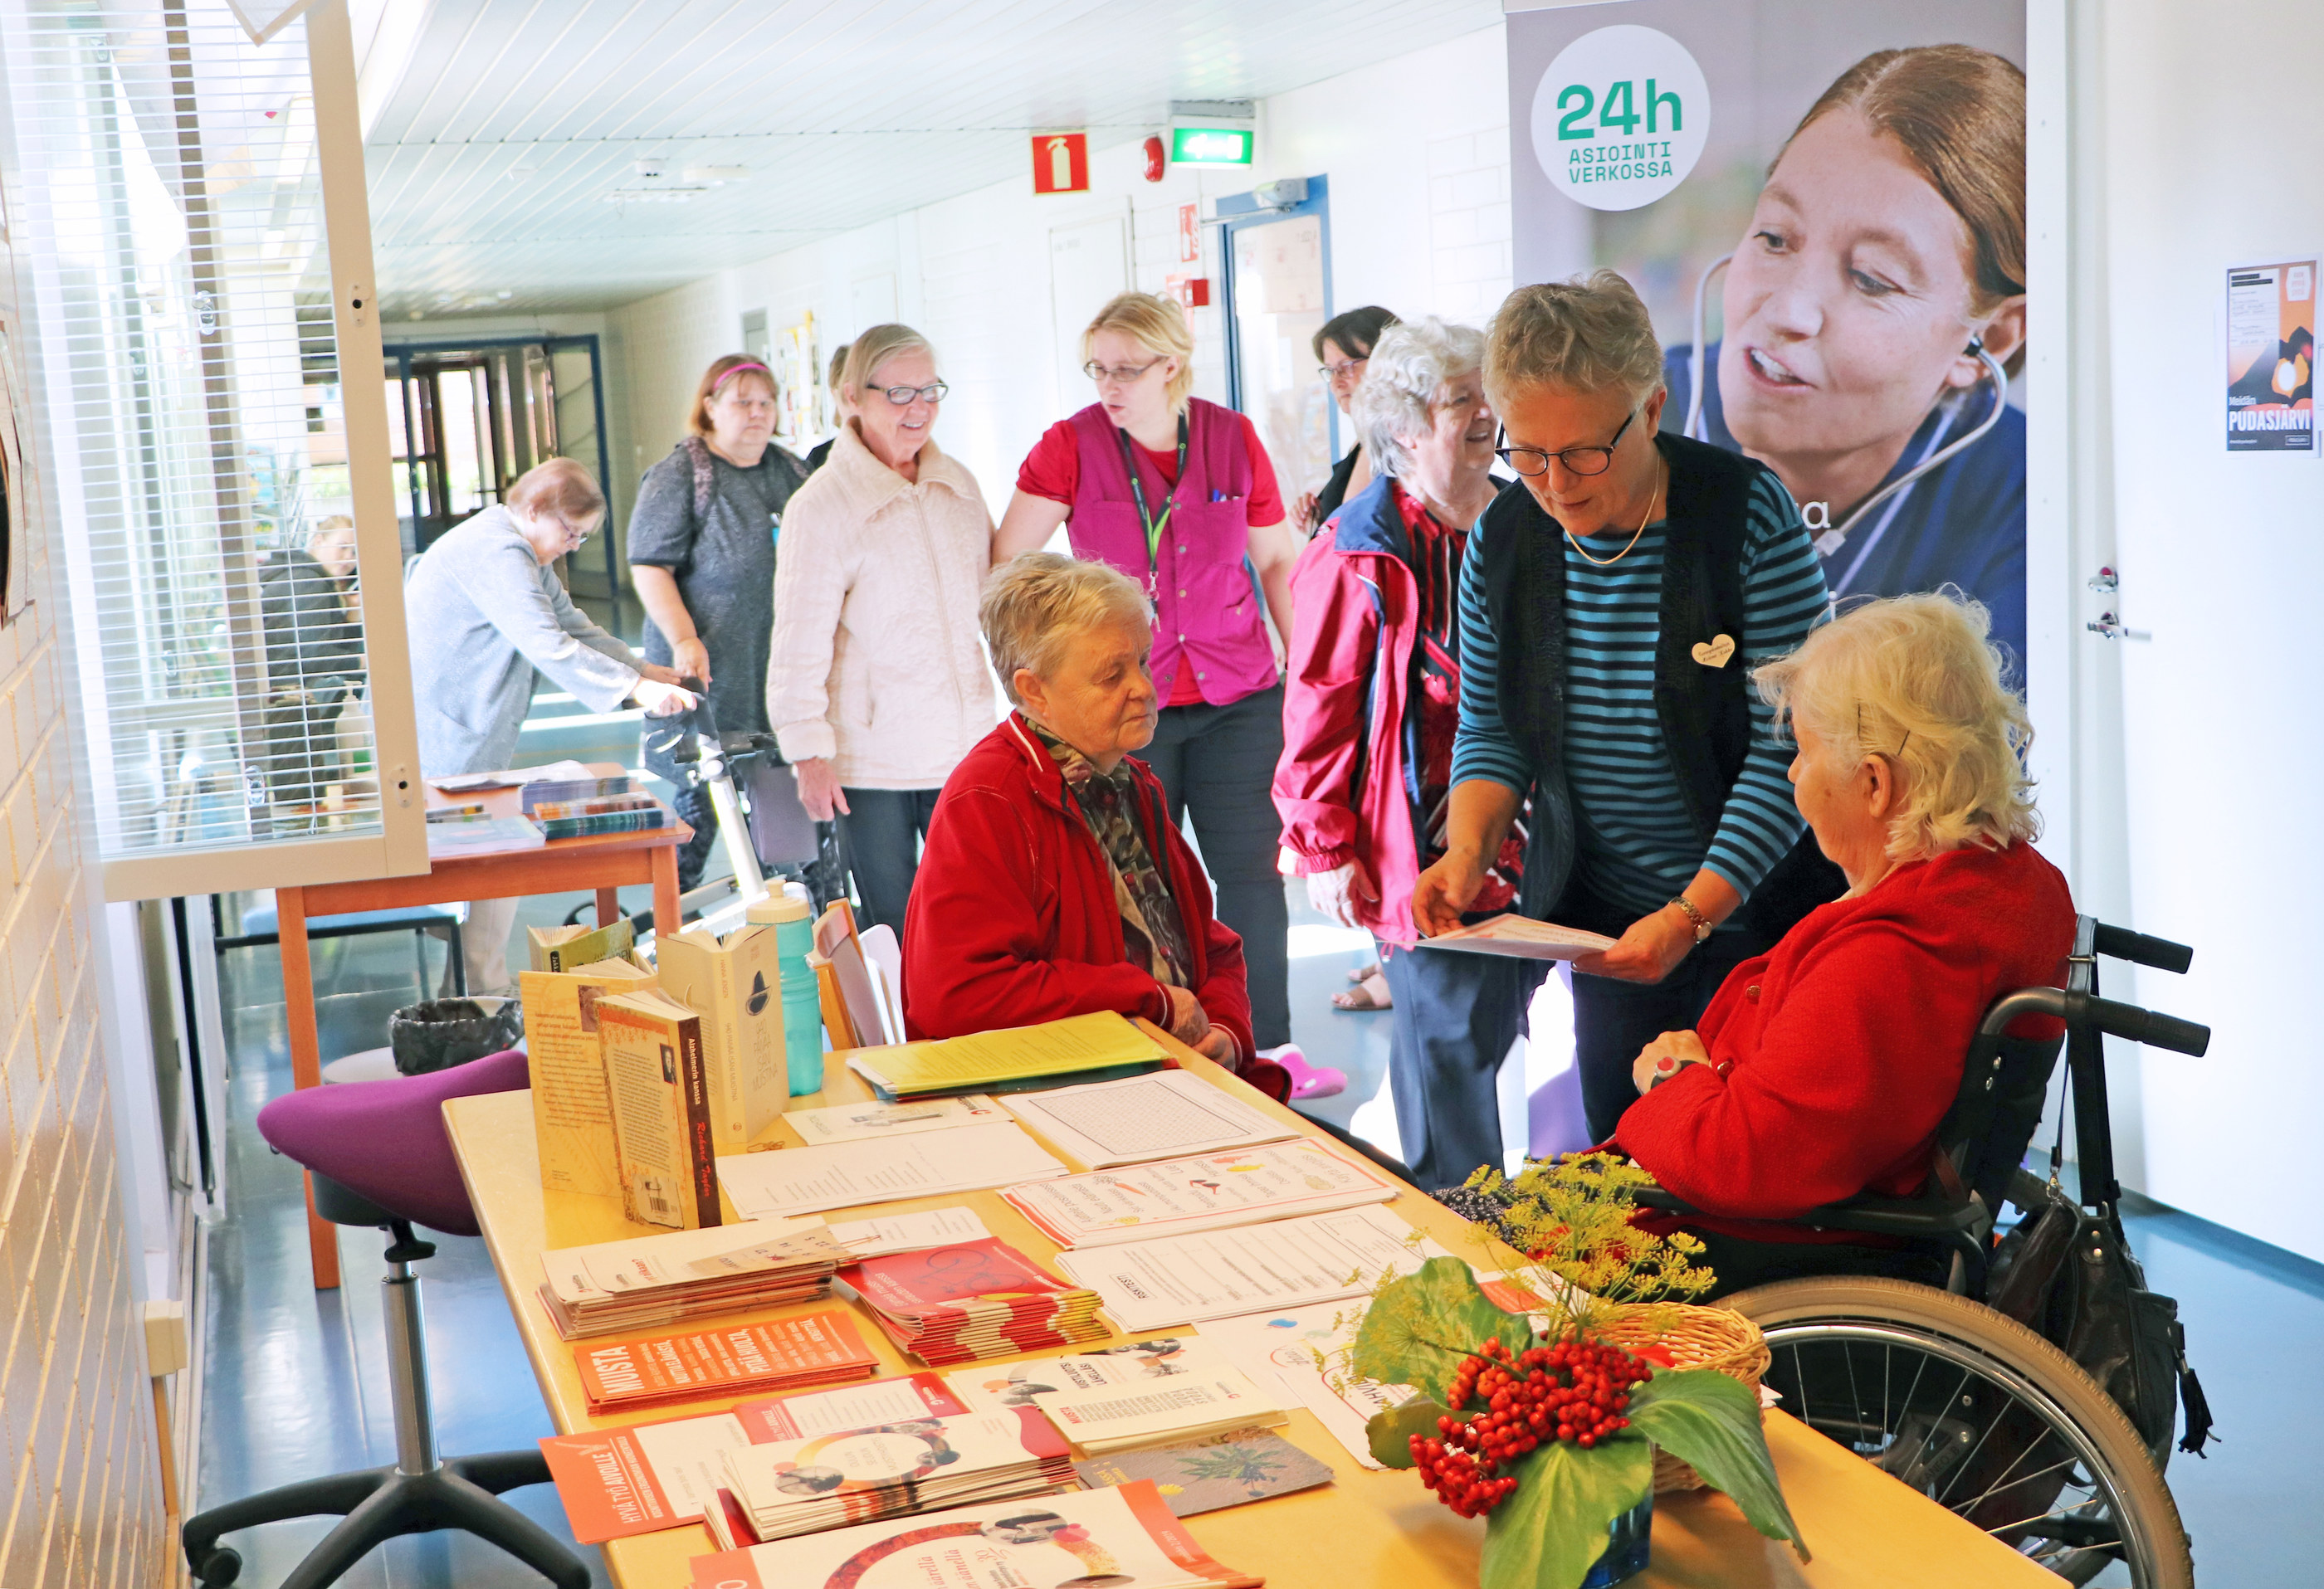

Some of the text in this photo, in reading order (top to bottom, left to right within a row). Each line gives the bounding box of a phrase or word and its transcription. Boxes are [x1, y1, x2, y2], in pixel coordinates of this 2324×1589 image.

[1557, 78, 1682, 141] 24h
[1569, 141, 1672, 164] ASIOINTI
[1569, 161, 1673, 184] VERKOSSA
[2229, 396, 2257, 407] Meidän
[2229, 404, 2311, 431] PUDASJÄRVI
[687, 1038, 701, 1104] Alzheimerin kanssa
[696, 1122, 713, 1197] Richard Taylor
[1164, 1164, 1184, 1175] Lue
[1116, 1275, 1150, 1299] RISKITESTI
[588, 1345, 645, 1394] MUISTA
[738, 1353, 772, 1373] PITÄÄ
[1059, 1406, 1082, 1424] MUISTA
[592, 1451, 643, 1523] HYVÄ TYÖ AIVOILLE
[945, 1548, 974, 1581] äänellä
[975, 1549, 997, 1562] 30
[918, 1556, 945, 1586] äärellä
